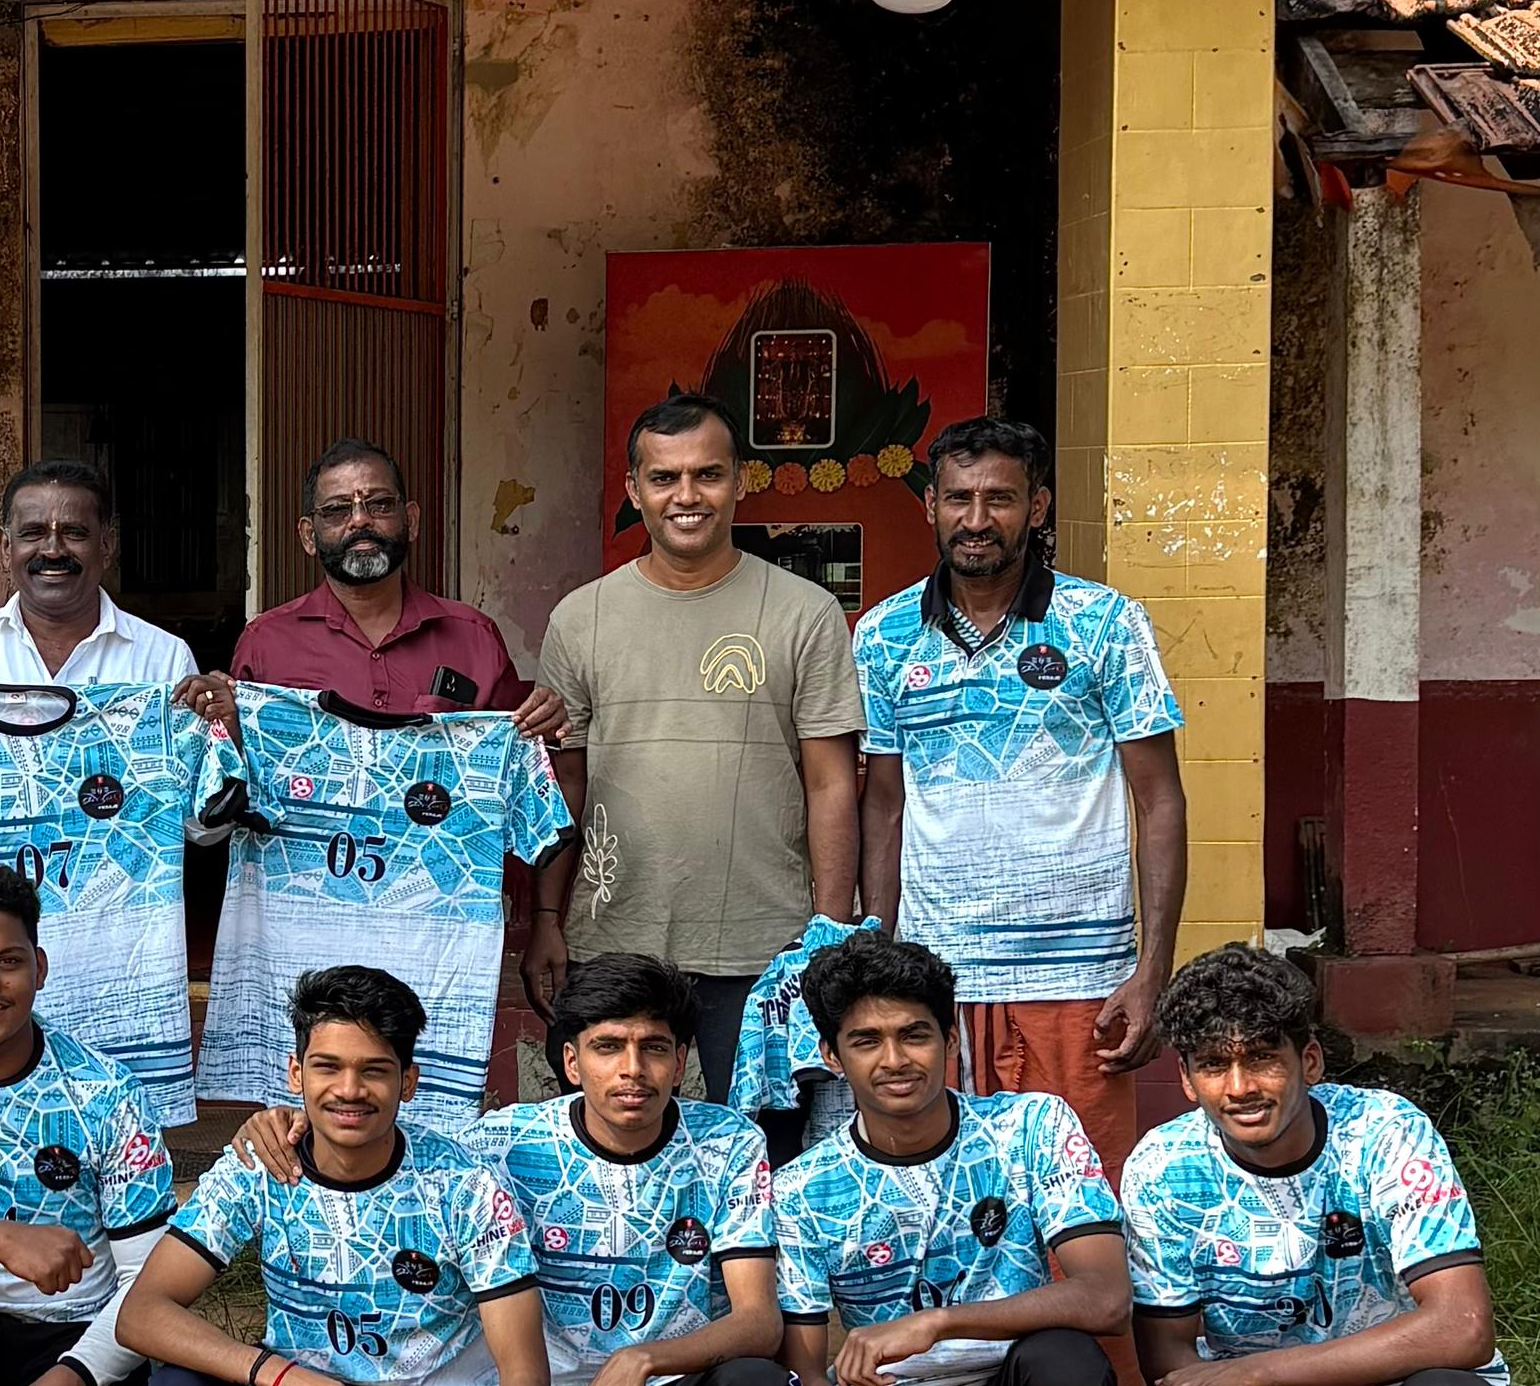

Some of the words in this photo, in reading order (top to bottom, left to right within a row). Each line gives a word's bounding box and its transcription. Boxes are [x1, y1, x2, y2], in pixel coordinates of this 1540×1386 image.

[15, 840, 73, 889] 07
[327, 832, 387, 883] 05
[591, 1283, 655, 1332] 09
[327, 1309, 389, 1357] 05
